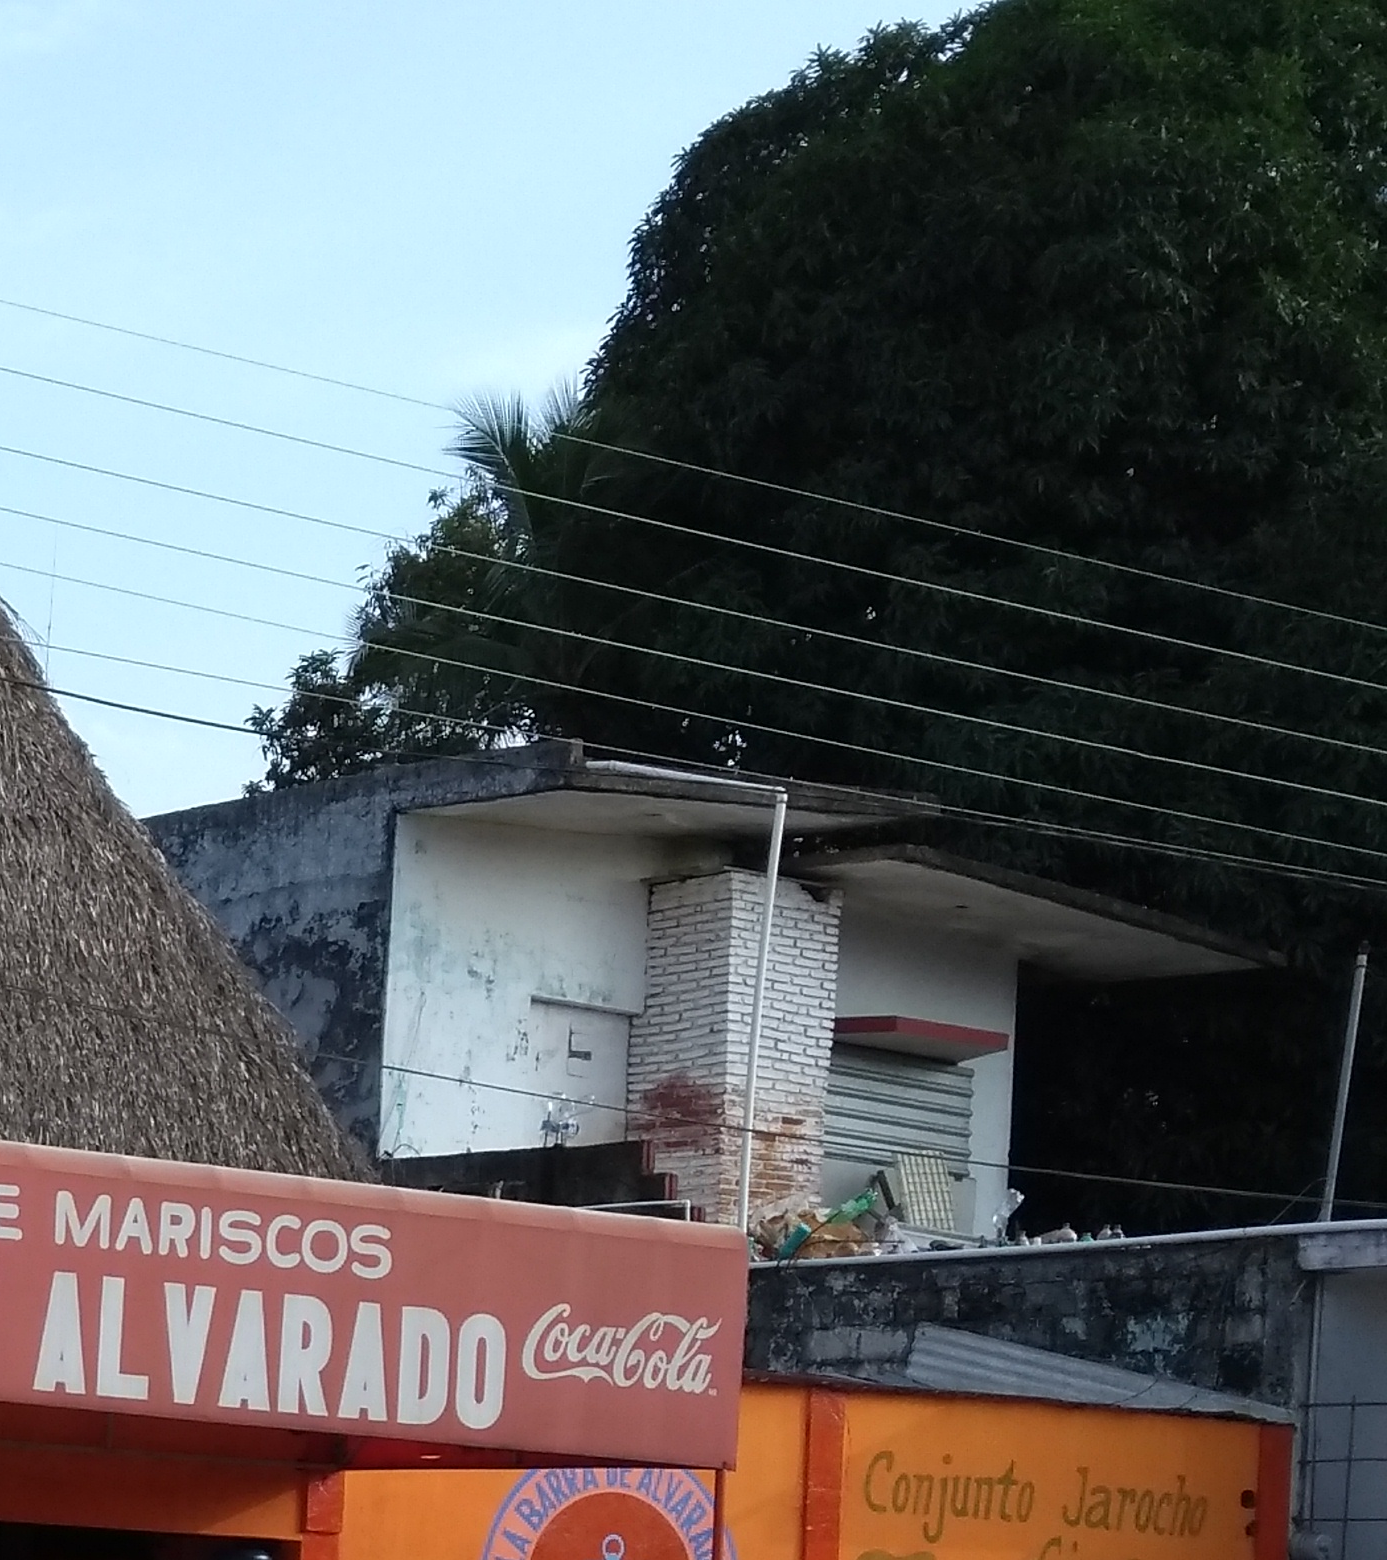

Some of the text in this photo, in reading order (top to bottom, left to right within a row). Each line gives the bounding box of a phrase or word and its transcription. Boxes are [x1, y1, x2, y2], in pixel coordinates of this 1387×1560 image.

[53, 1189, 393, 1281] MARISCOS
[33, 1270, 508, 1431] ALVARADO
[522, 1302, 723, 1396] Coca-Cola
[863, 1449, 1210, 1544] Conjunto Jarocho
